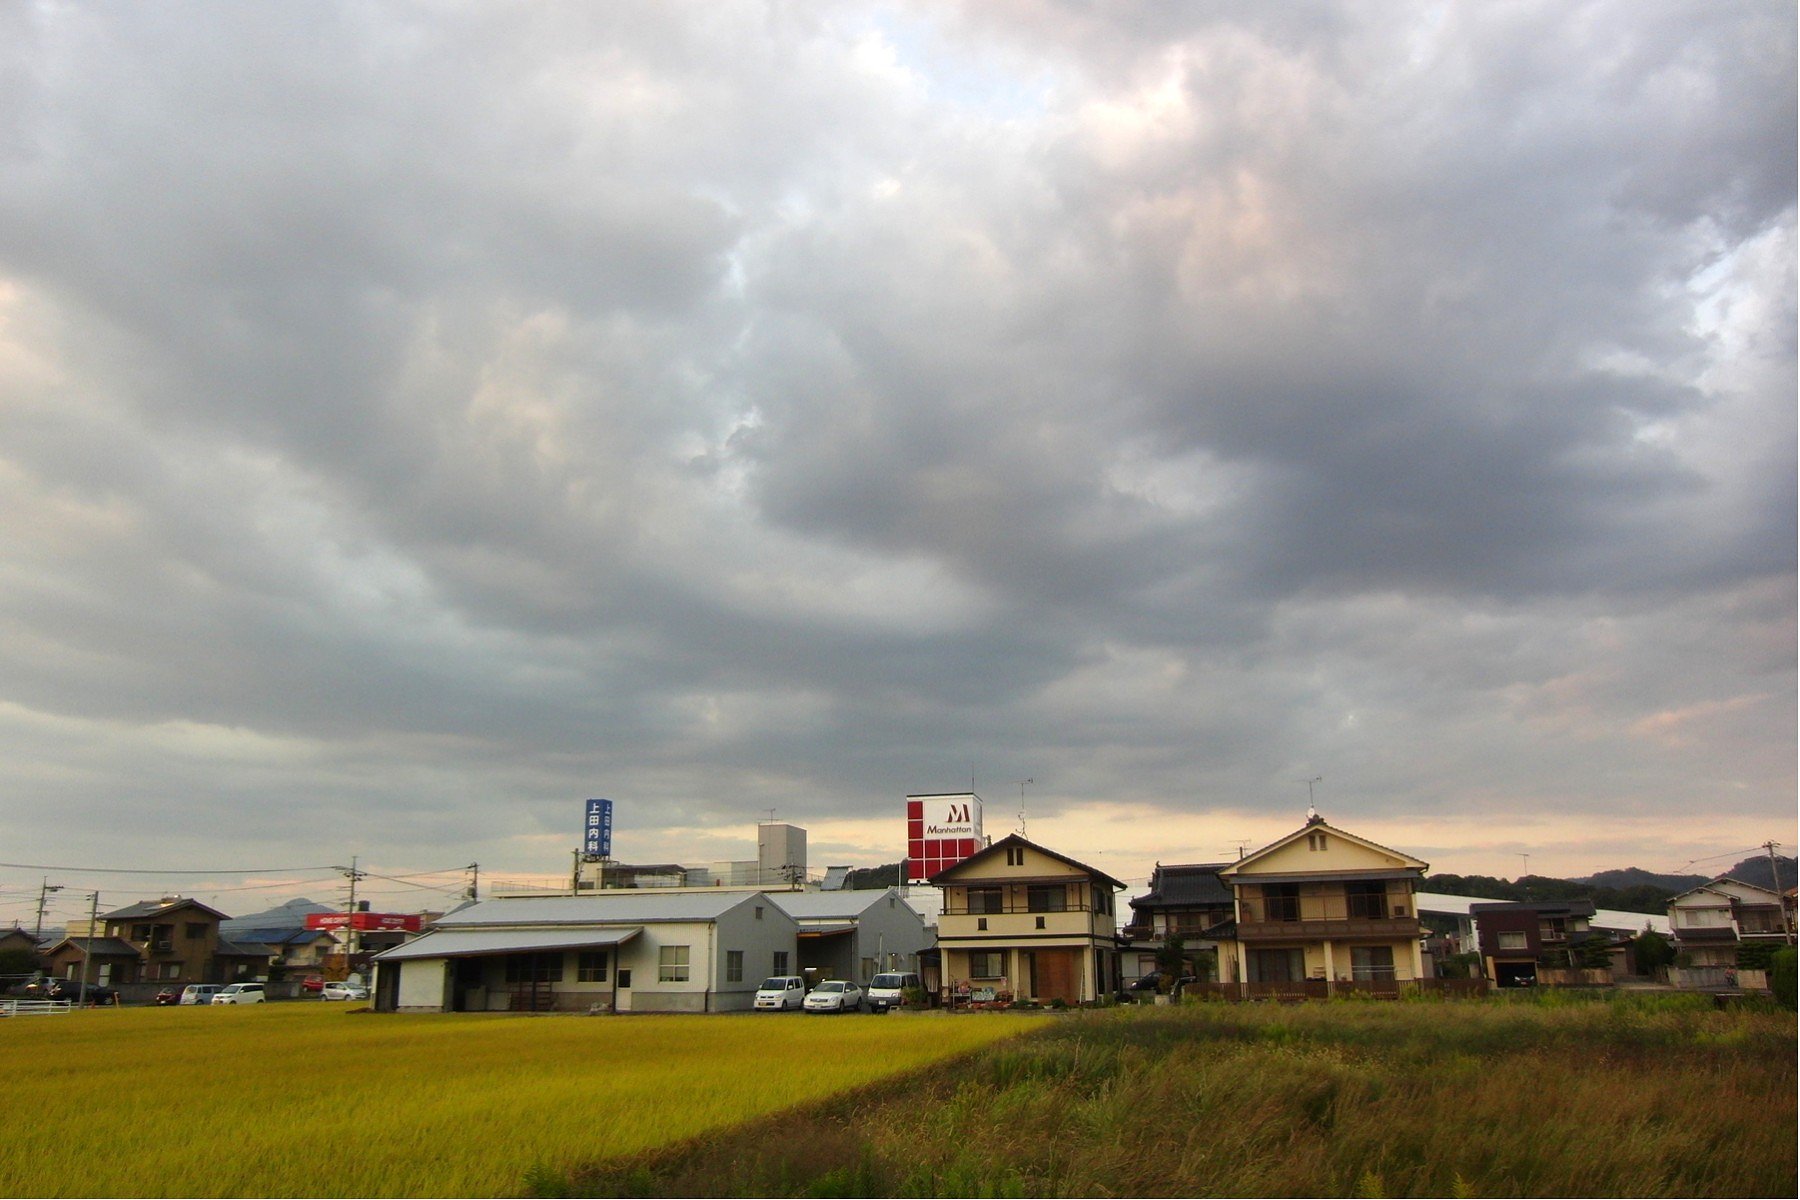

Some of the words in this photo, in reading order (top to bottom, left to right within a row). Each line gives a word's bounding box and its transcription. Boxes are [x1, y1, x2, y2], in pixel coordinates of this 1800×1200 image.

[947, 803, 970, 823] M
[588, 802, 600, 852] 上田内科
[926, 825, 972, 834] Manhattan
